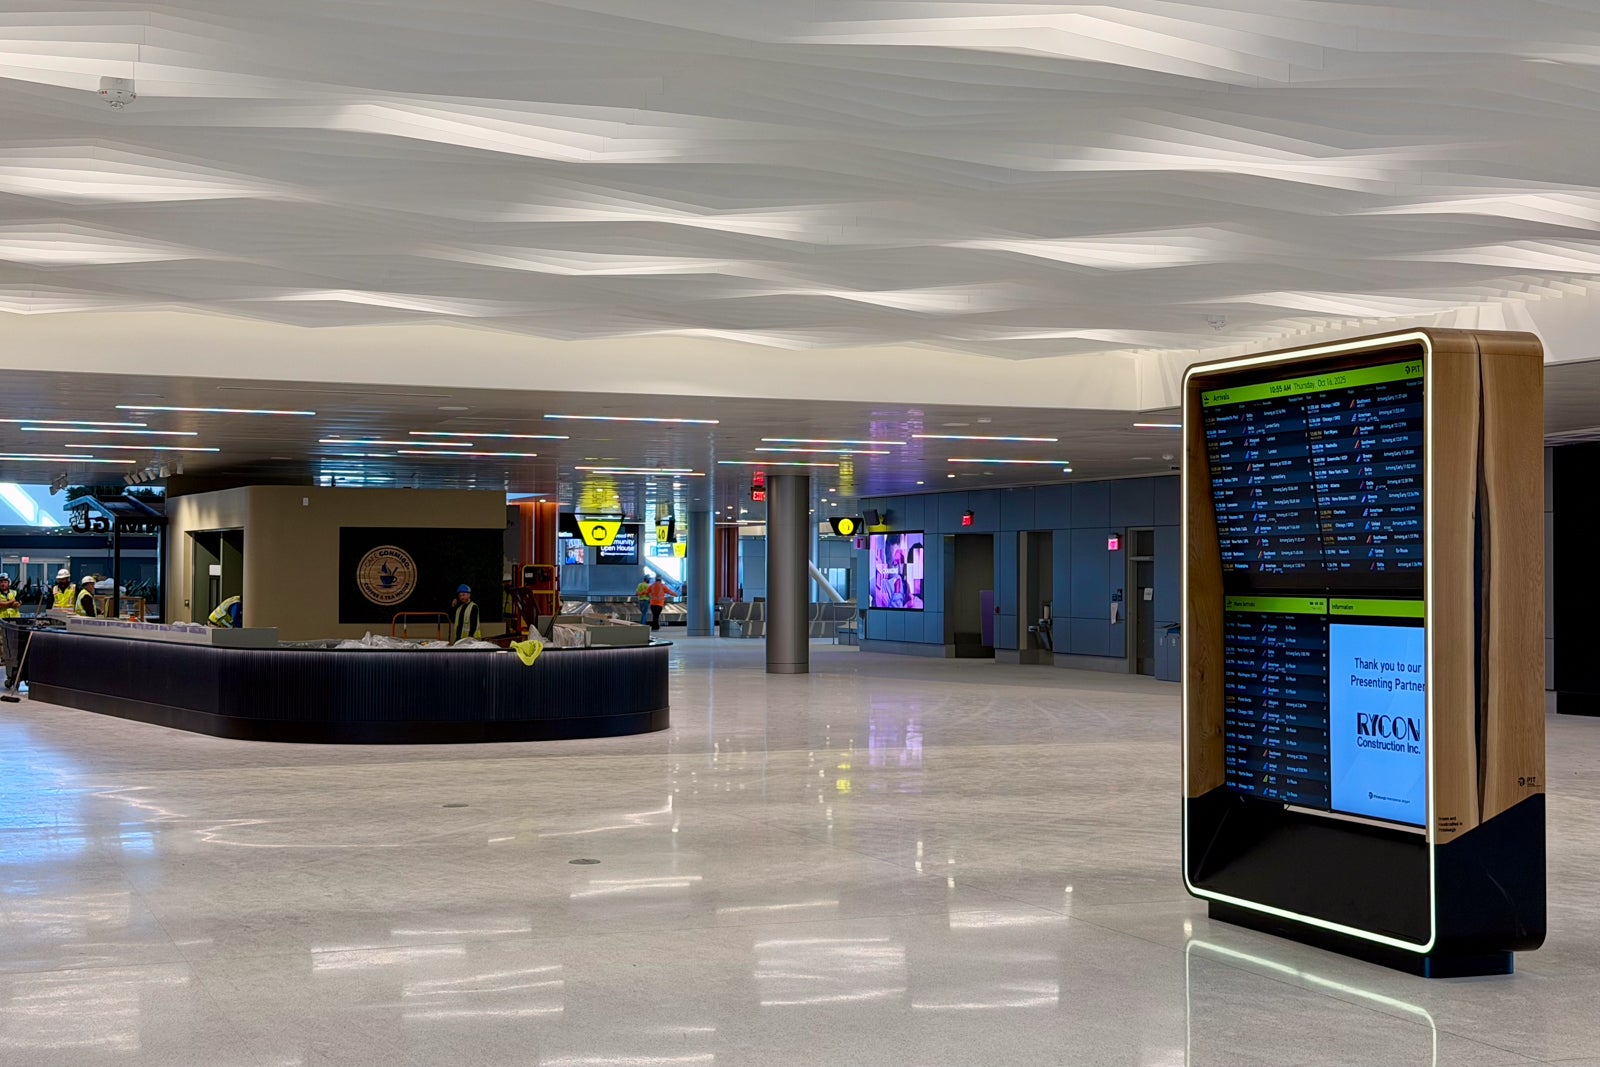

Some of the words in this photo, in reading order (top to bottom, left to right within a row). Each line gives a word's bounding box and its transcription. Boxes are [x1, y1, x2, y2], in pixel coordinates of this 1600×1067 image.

[1270, 384, 1282, 394] 10:55
[1335, 376, 1346, 384] 2025
[1213, 393, 1230, 401] Arrivals
[1354, 657, 1378, 670] Thank
[1380, 662, 1394, 673] you
[1397, 662, 1405, 672] to
[1407, 664, 1422, 673] our
[1351, 674, 1392, 692] Presenting
[1357, 712, 1420, 742] RYCON
[1357, 736, 1405, 752] Construction
[1407, 742, 1421, 754] Inc.
